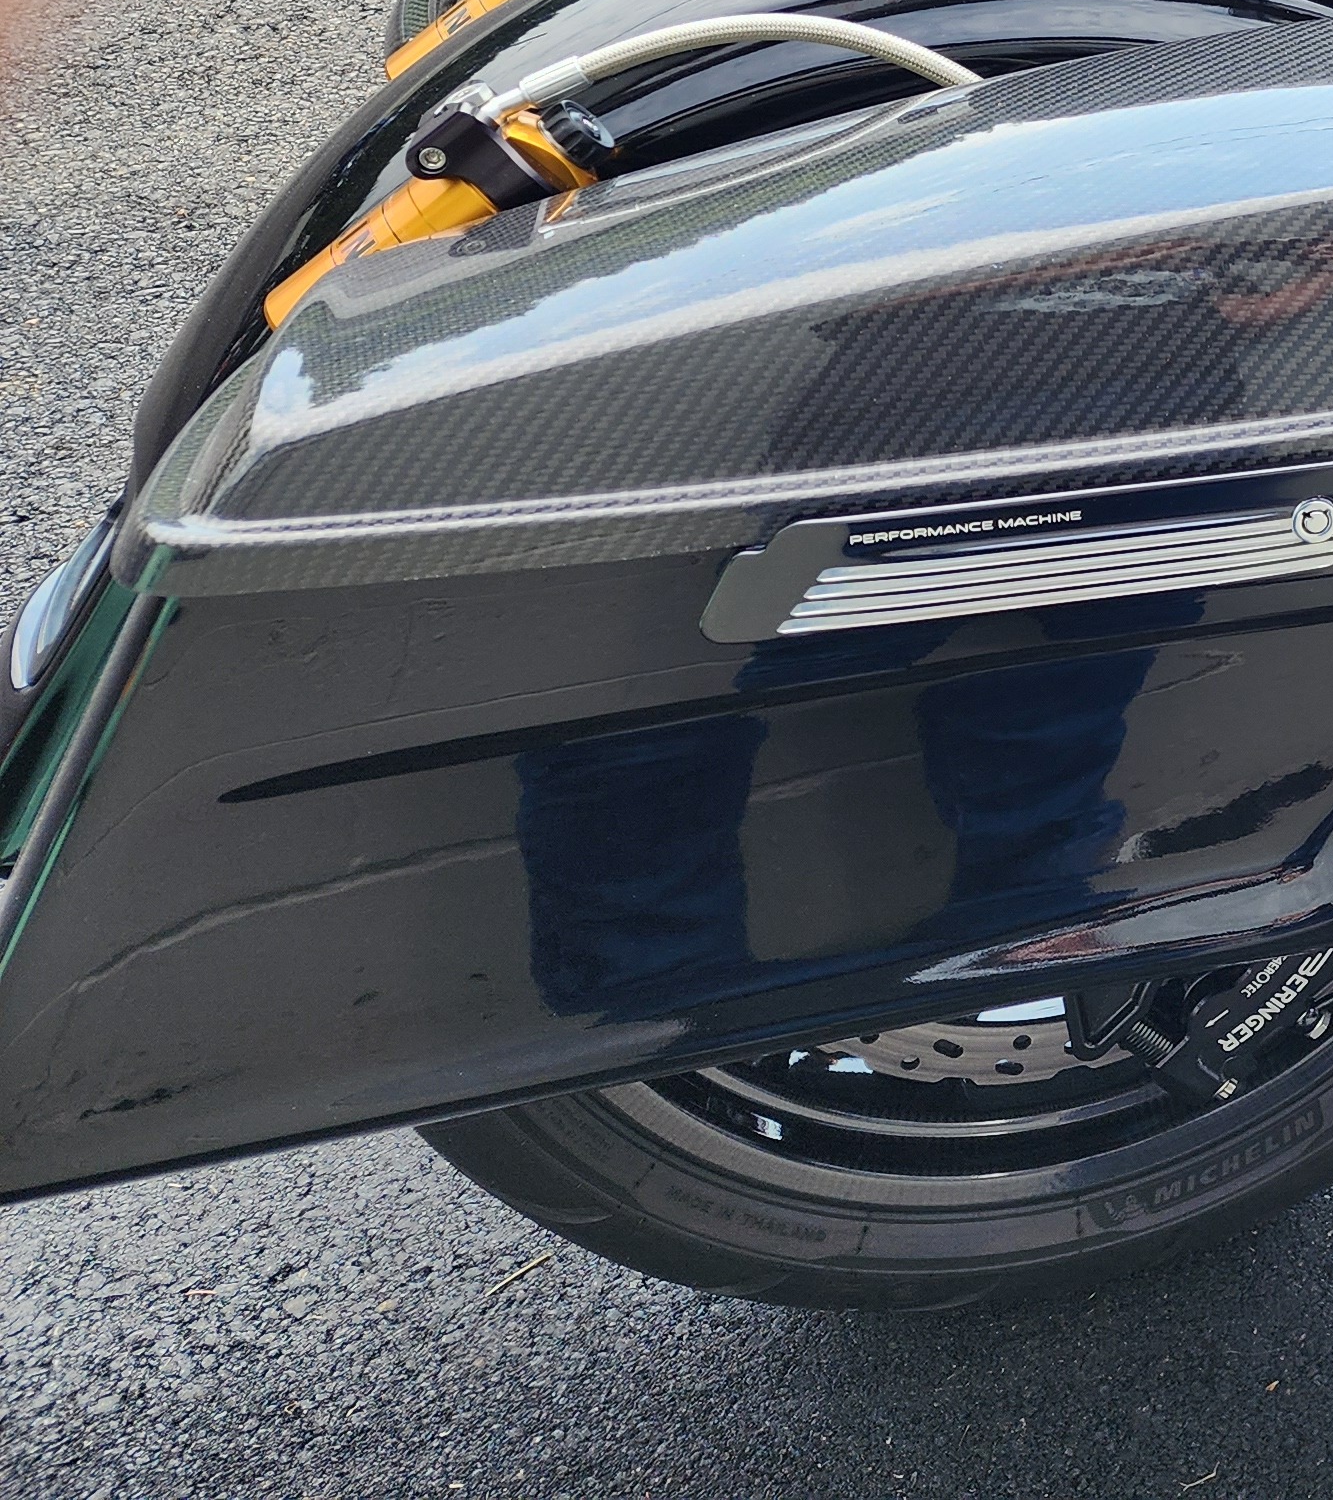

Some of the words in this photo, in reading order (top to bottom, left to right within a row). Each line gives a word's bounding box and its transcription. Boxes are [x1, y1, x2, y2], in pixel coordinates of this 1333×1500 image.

[848, 519, 994, 546] PERFORMANCE
[997, 509, 1083, 530] MACHINE
[1152, 1109, 1317, 1205] MICHELIN
